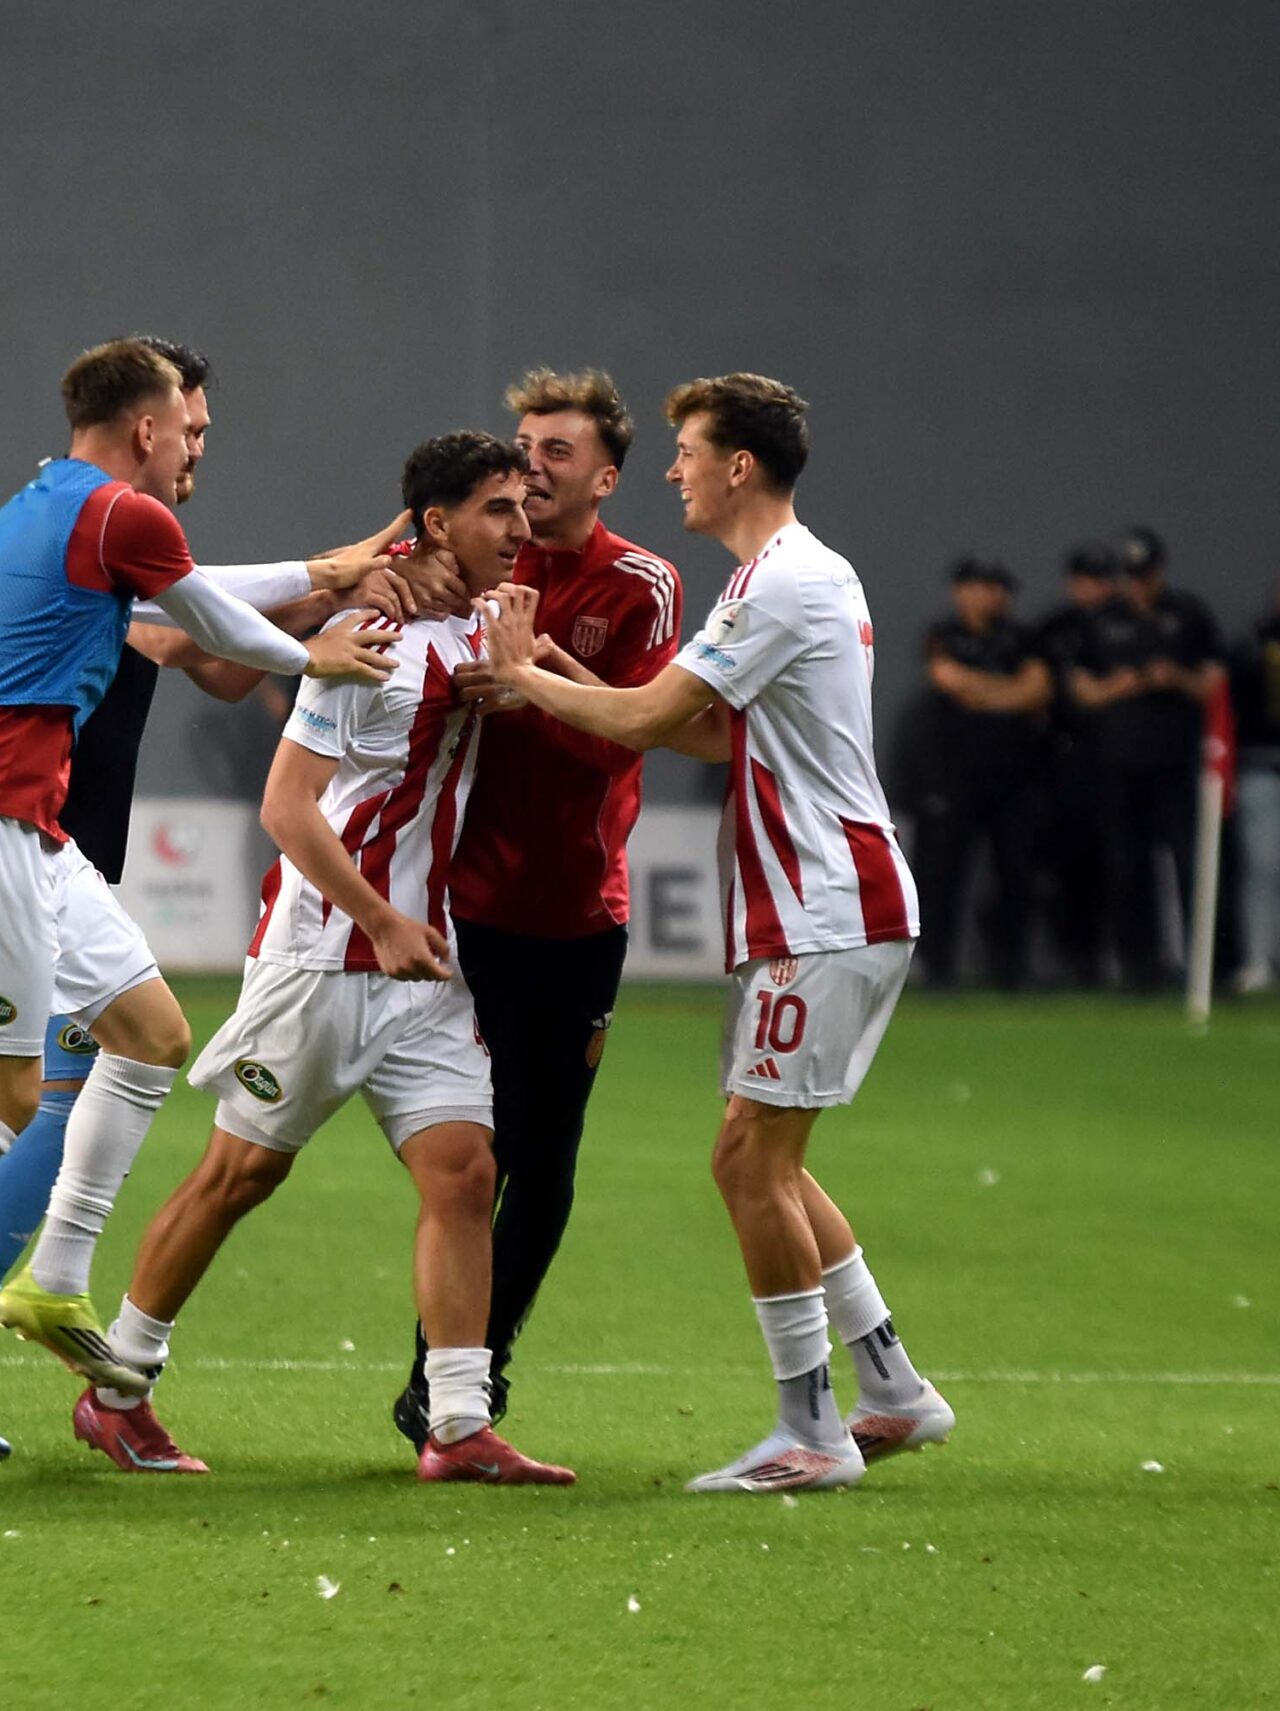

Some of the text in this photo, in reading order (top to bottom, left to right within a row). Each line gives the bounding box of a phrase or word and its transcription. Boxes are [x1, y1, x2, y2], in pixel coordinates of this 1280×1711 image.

[640, 866, 706, 953] E
[754, 989, 808, 1055] 10
[241, 1064, 280, 1097] Özgün
